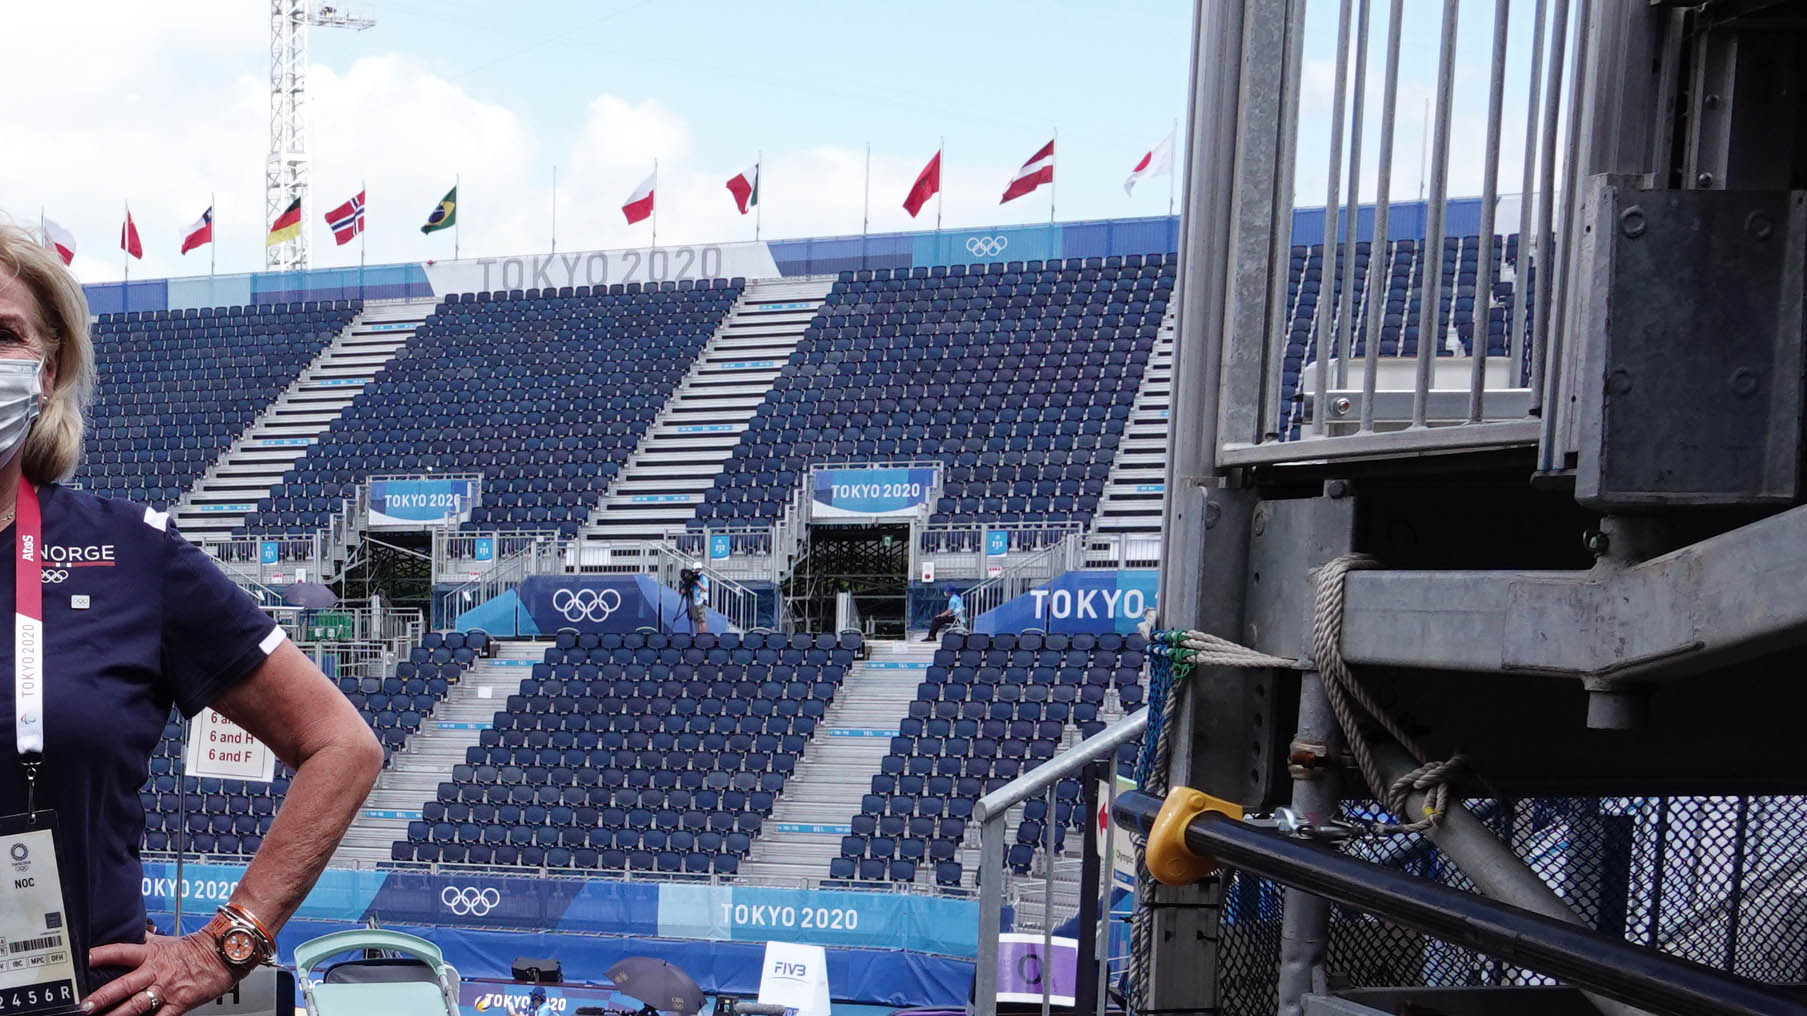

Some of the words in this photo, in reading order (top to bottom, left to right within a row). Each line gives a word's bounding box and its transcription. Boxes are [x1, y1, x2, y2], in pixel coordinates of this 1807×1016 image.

[476, 251, 609, 291] TOKYO
[621, 246, 722, 283] 2020
[831, 484, 880, 498] TOKYO
[883, 483, 921, 497] 2020
[384, 494, 427, 507] TOKYO
[1030, 589, 1144, 619] TOKYO
[22, 624, 35, 654] 2020
[22, 657, 35, 698] TOKYO
[211, 712, 218, 724] 6
[210, 730, 216, 742] 6
[220, 733, 242, 744] and
[245, 732, 254, 744] H
[208, 749, 215, 760] 6
[219, 751, 241, 762] and
[245, 751, 253, 763] F
[14, 878, 35, 889] NOC
[141, 877, 190, 898] OKYO
[721, 904, 795, 926] TOKYO
[801, 908, 858, 930] 2020
[774, 961, 807, 976] FIVB
[485, 993, 531, 1009] TOKYO
